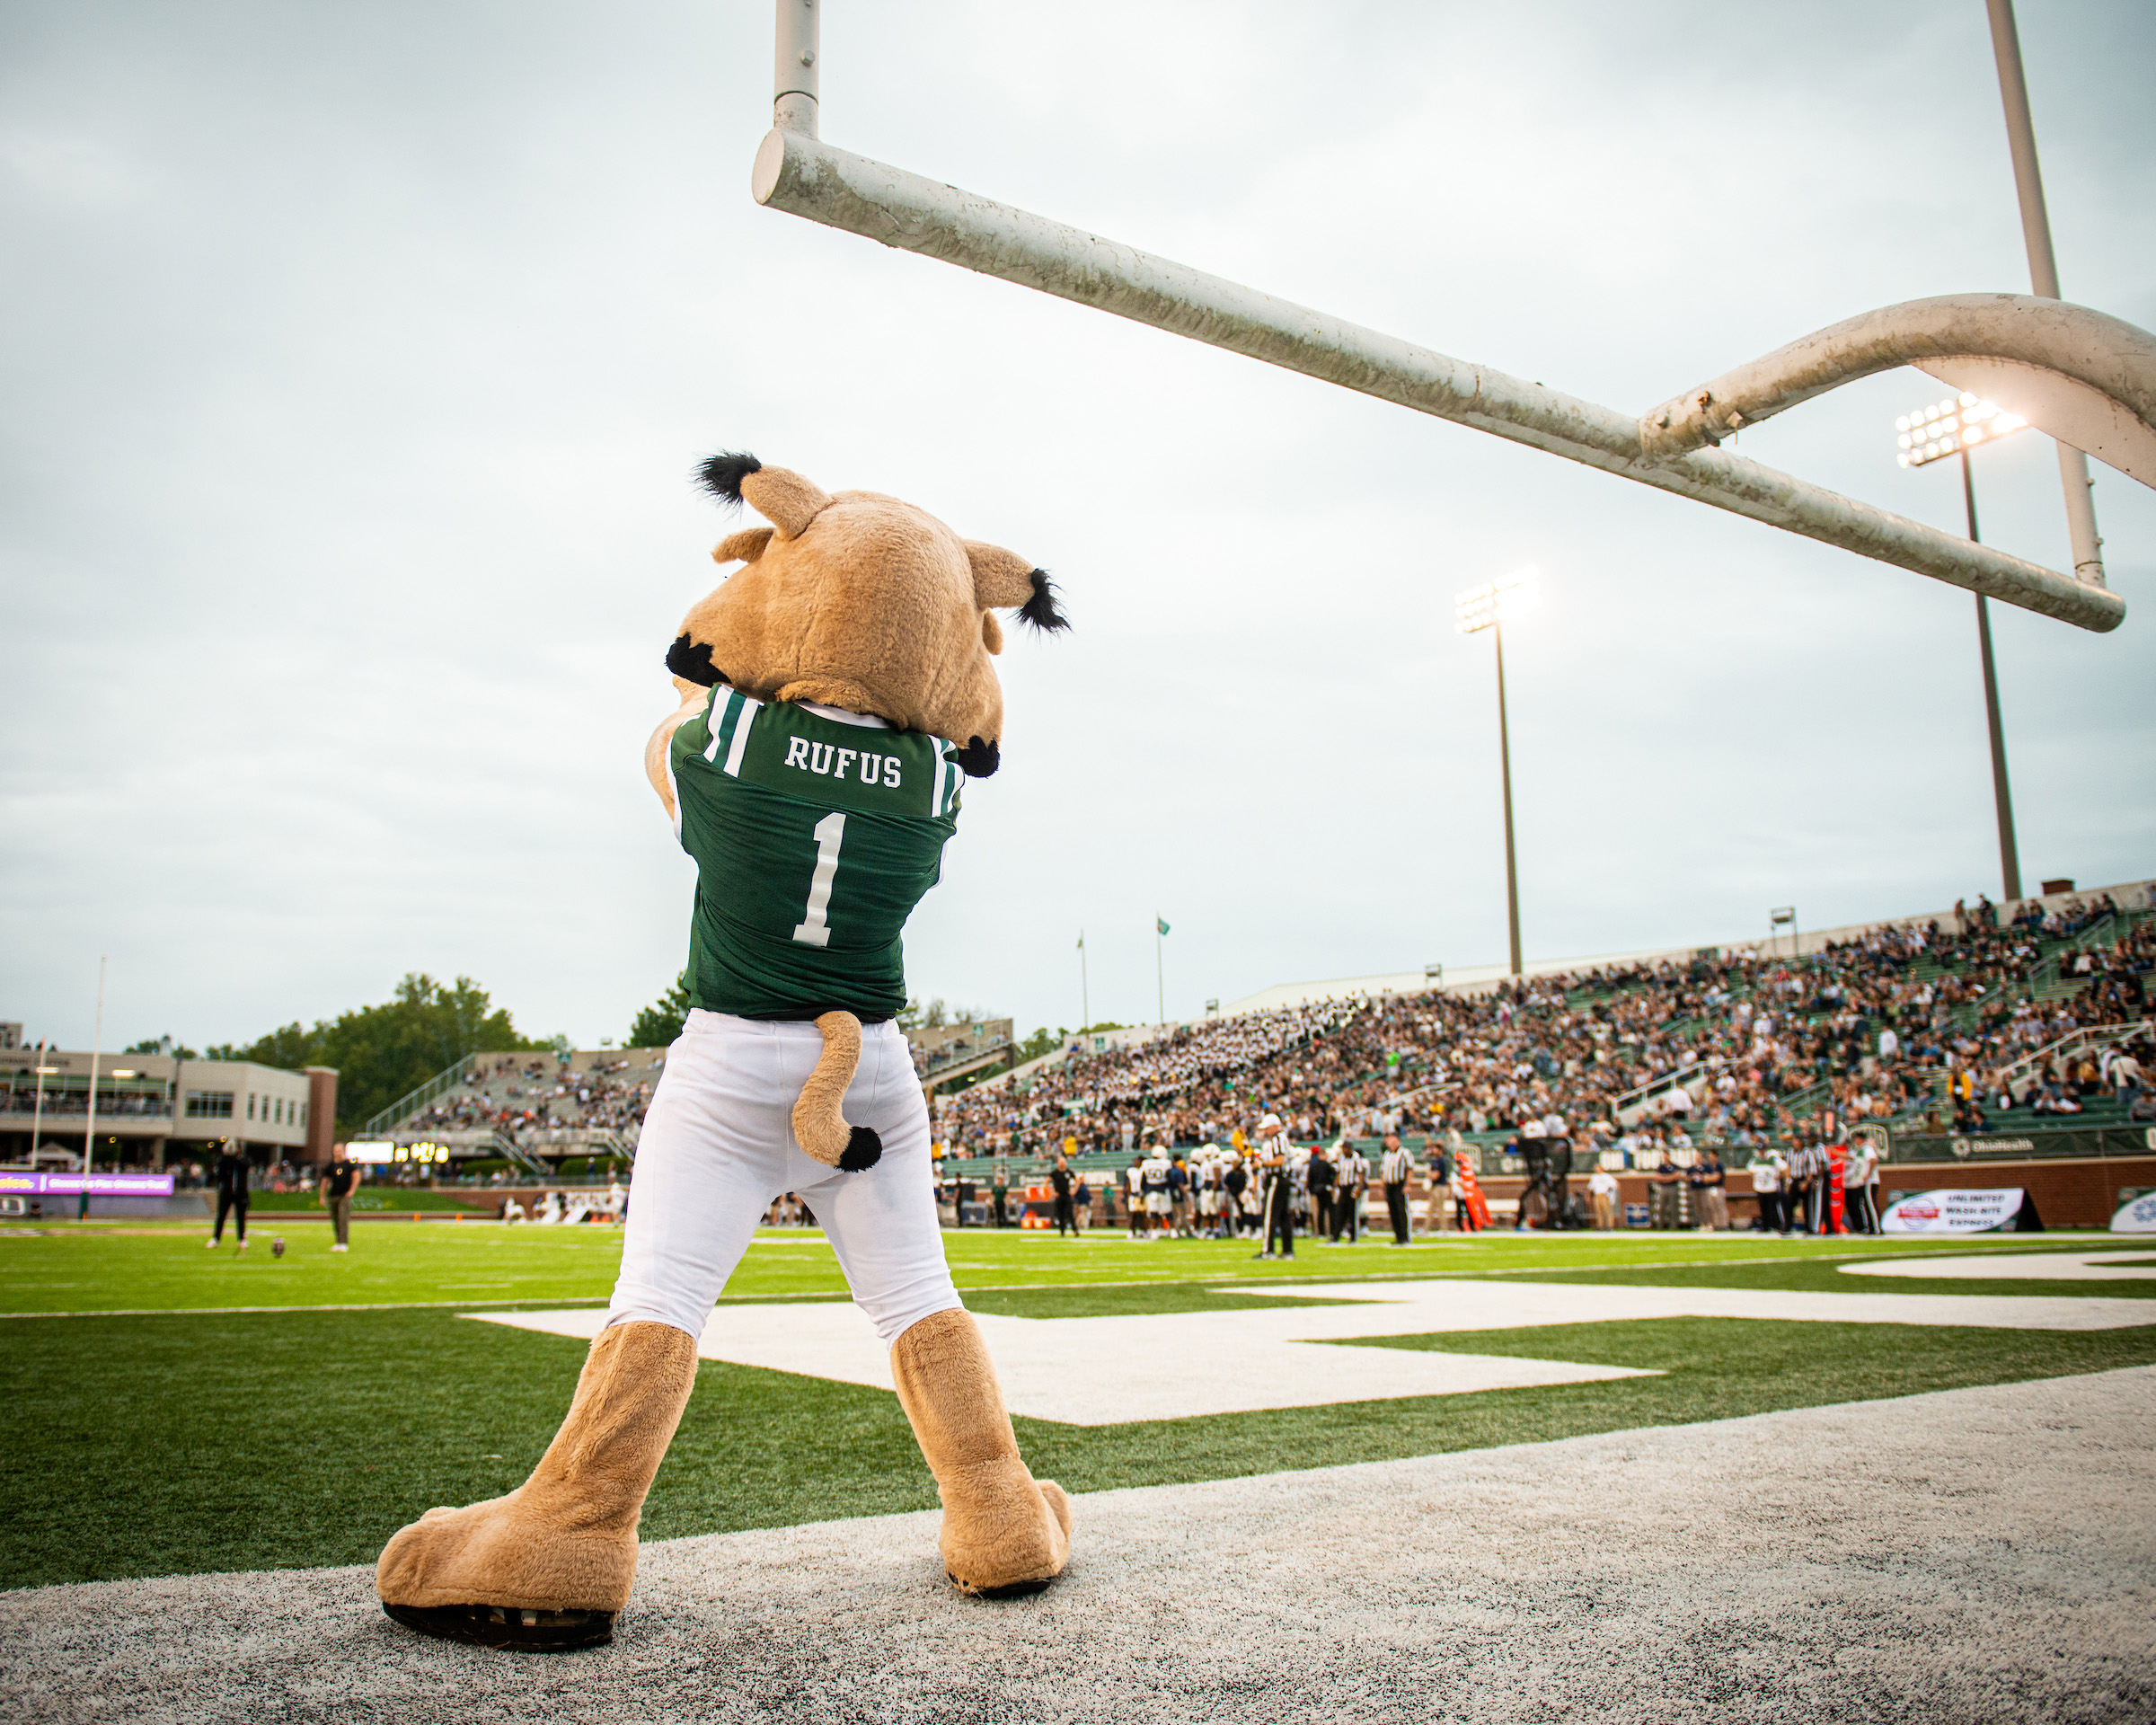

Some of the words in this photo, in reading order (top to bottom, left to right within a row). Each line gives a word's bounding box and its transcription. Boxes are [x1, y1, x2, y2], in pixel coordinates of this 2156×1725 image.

[784, 735, 902, 789] RUFUS
[792, 812, 846, 947] 1
[1147, 1168, 1162, 1180] 50
[1948, 1193, 2006, 1203] UNLIMITED
